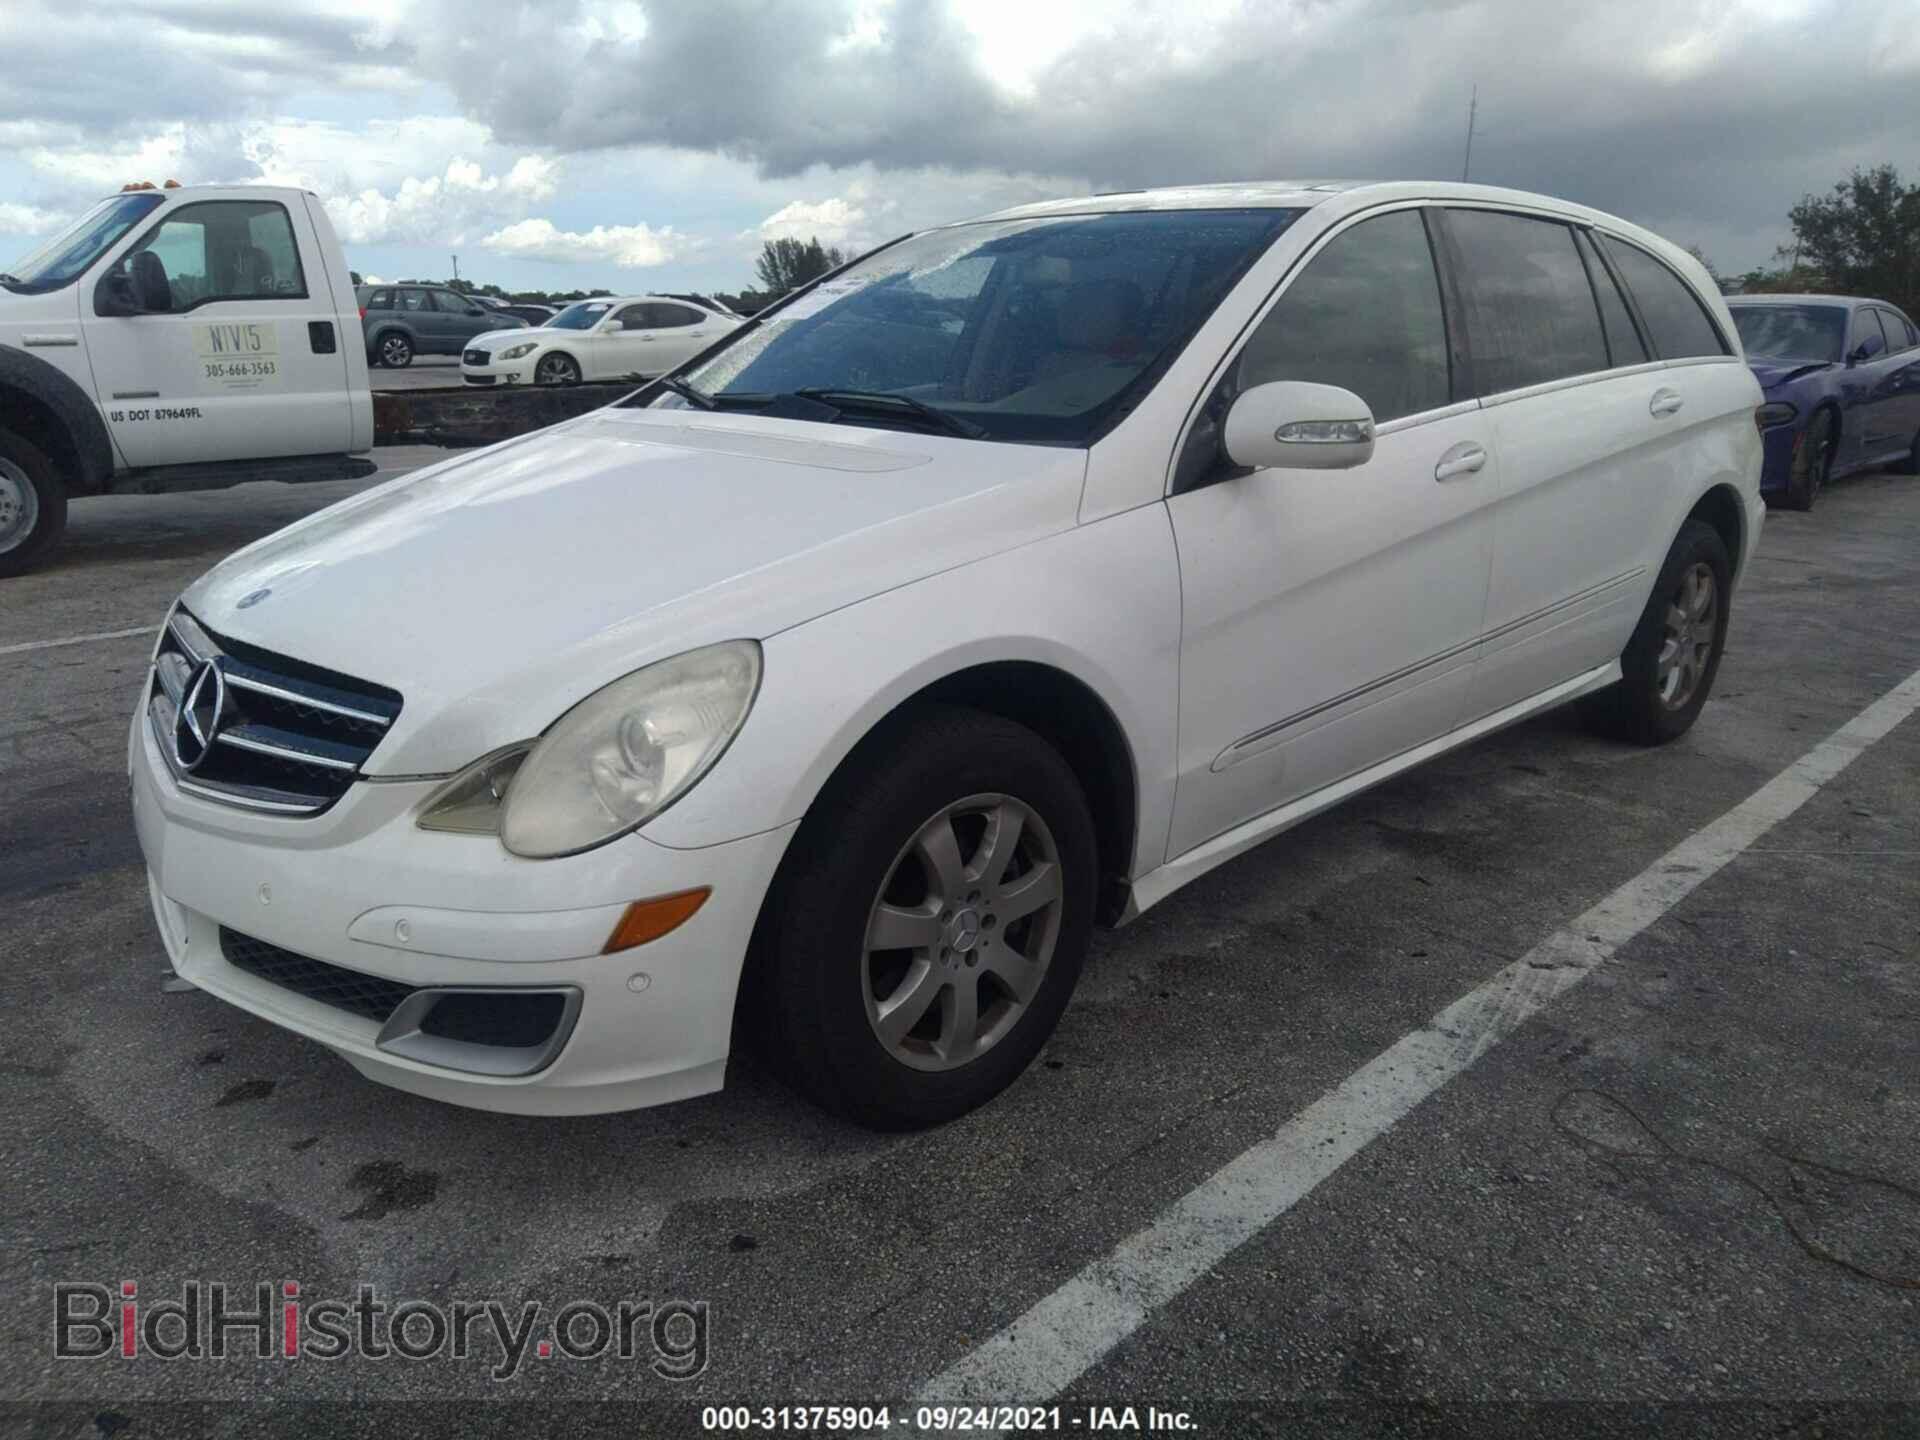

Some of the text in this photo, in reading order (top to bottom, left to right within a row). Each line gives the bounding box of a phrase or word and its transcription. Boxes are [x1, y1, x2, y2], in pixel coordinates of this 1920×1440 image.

[205, 362, 276, 378] 305-666-3563
[110, 411, 125, 422] US
[128, 409, 151, 421] DOT
